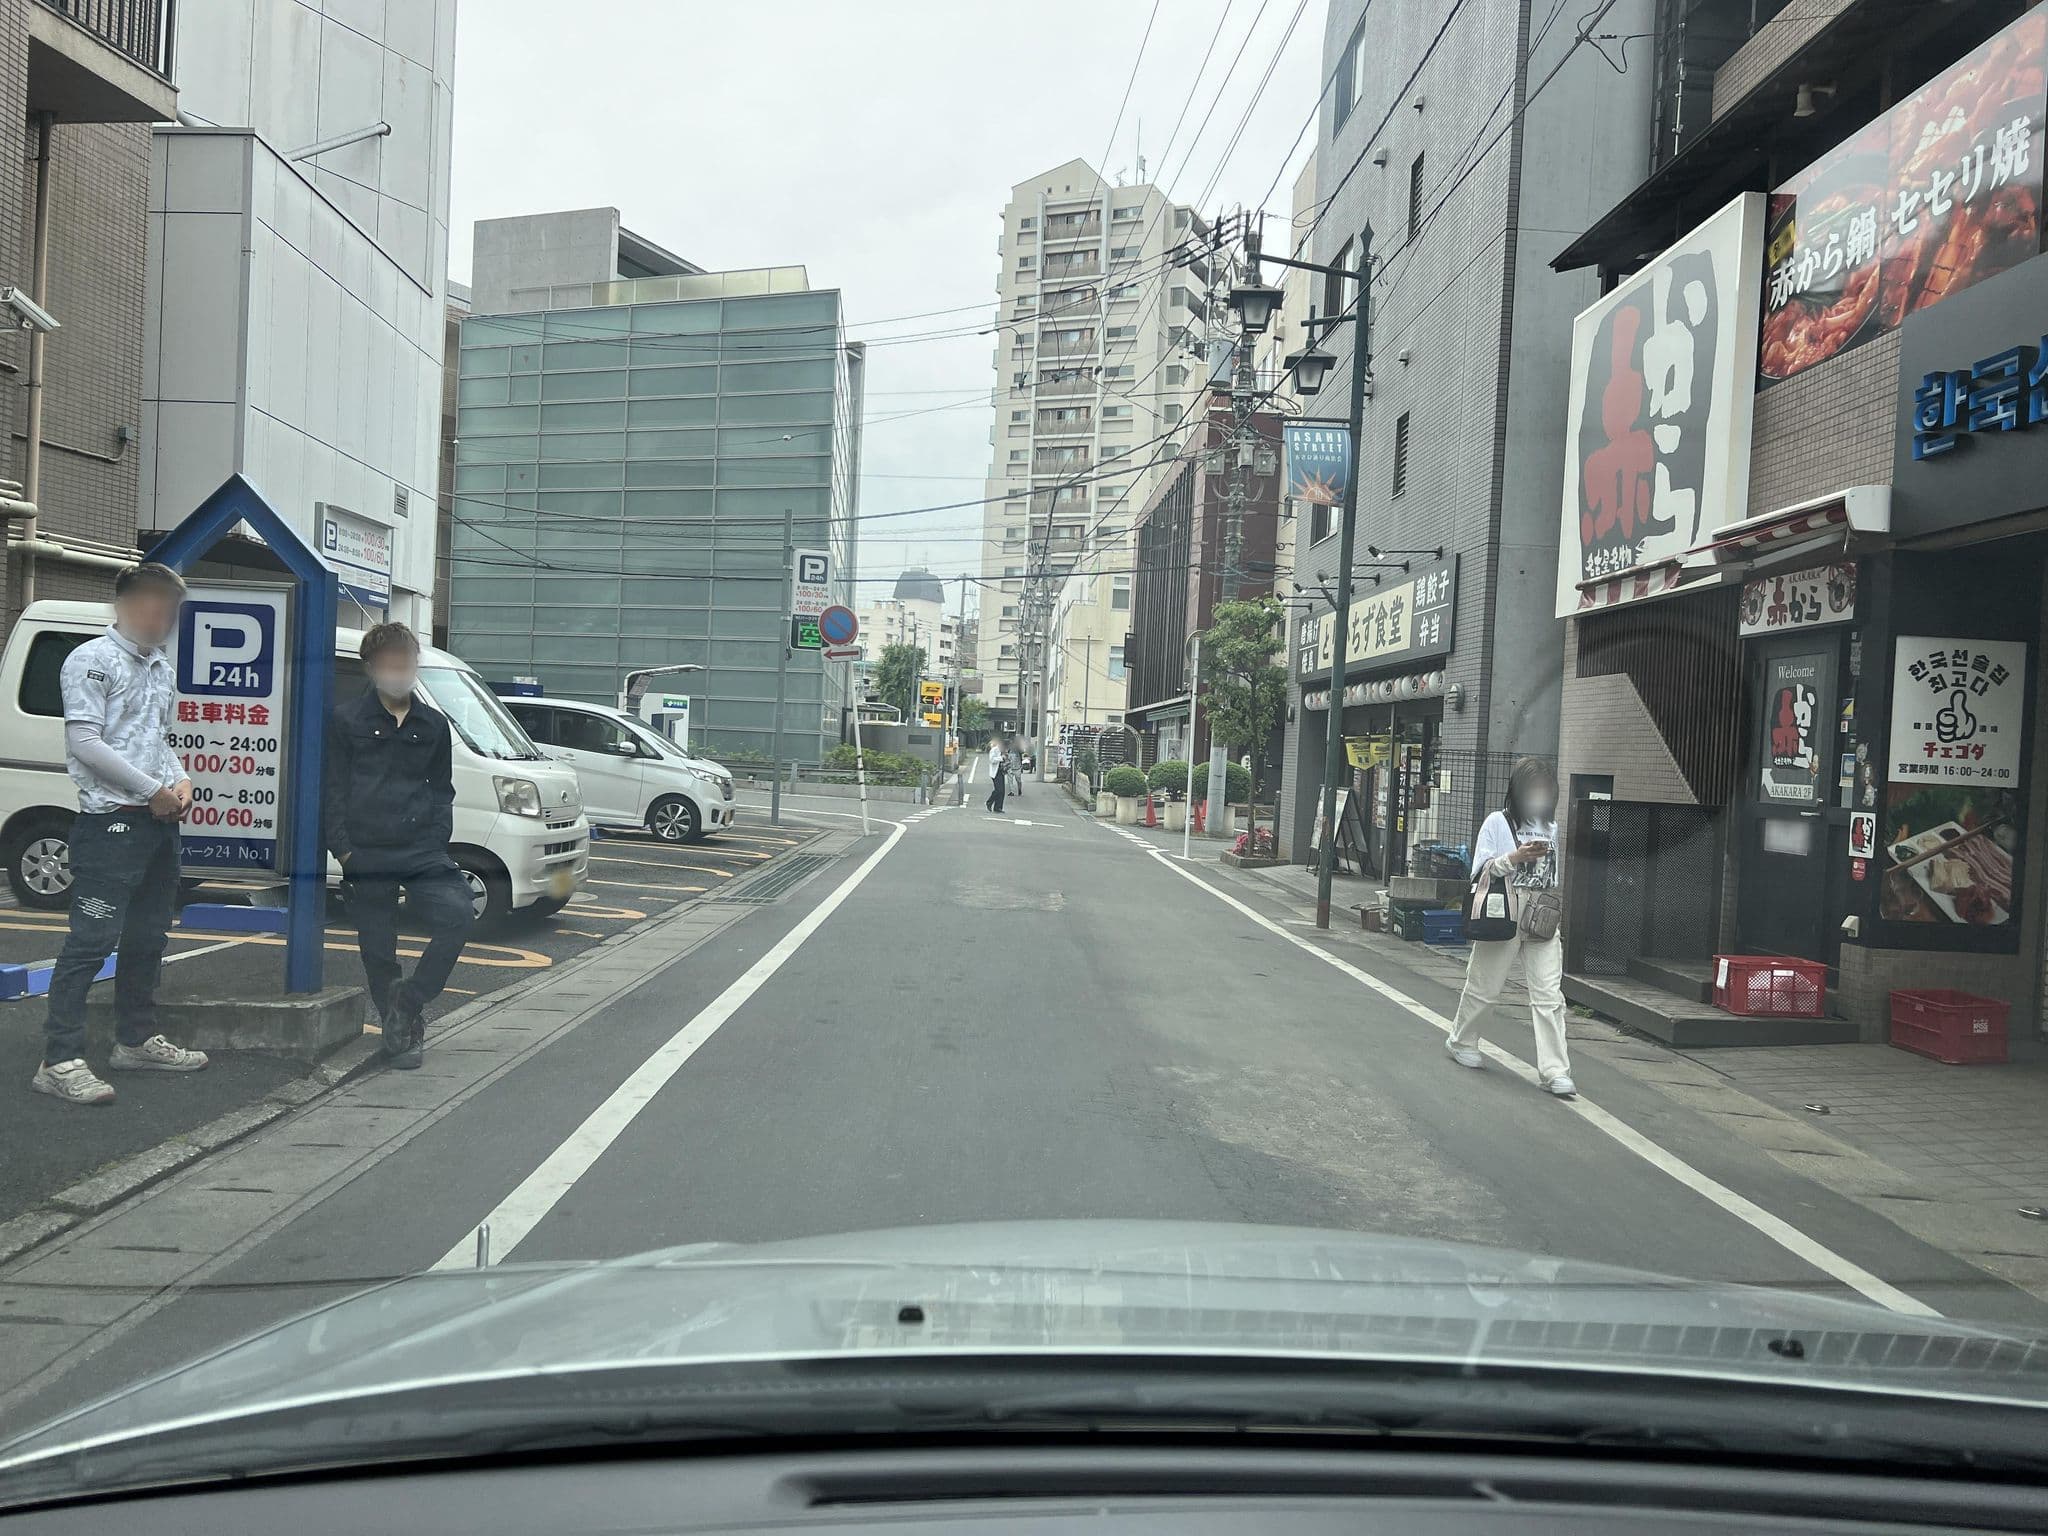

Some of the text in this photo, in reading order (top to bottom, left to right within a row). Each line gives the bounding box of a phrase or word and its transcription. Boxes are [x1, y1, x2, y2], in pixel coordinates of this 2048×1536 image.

[1769, 115, 2030, 312] 赤から鍋 セセリ焼
[1293, 431, 1342, 443] ASAHI
[1294, 443, 1342, 453] STREET
[1585, 544, 1632, 577] 名古屋名物
[1416, 569, 1450, 608] 鶏餃子
[1767, 577, 1821, 626] 赤から
[1419, 613, 1440, 647] 弁当
[192, 612, 263, 685] P
[212, 666, 260, 687] 24h
[1778, 665, 1815, 679] Welcome
[1928, 670, 1990, 696] 최고다
[177, 701, 269, 725] 駐車料金
[168, 733, 205, 749] 8:00
[230, 737, 277, 752] 24:00
[1923, 742, 1987, 761] チェゴダ
[1898, 763, 2010, 778] 営業時間 16:00～24:00
[1770, 785, 1801, 798] AKAKARA
[238, 847, 269, 860] No.1
